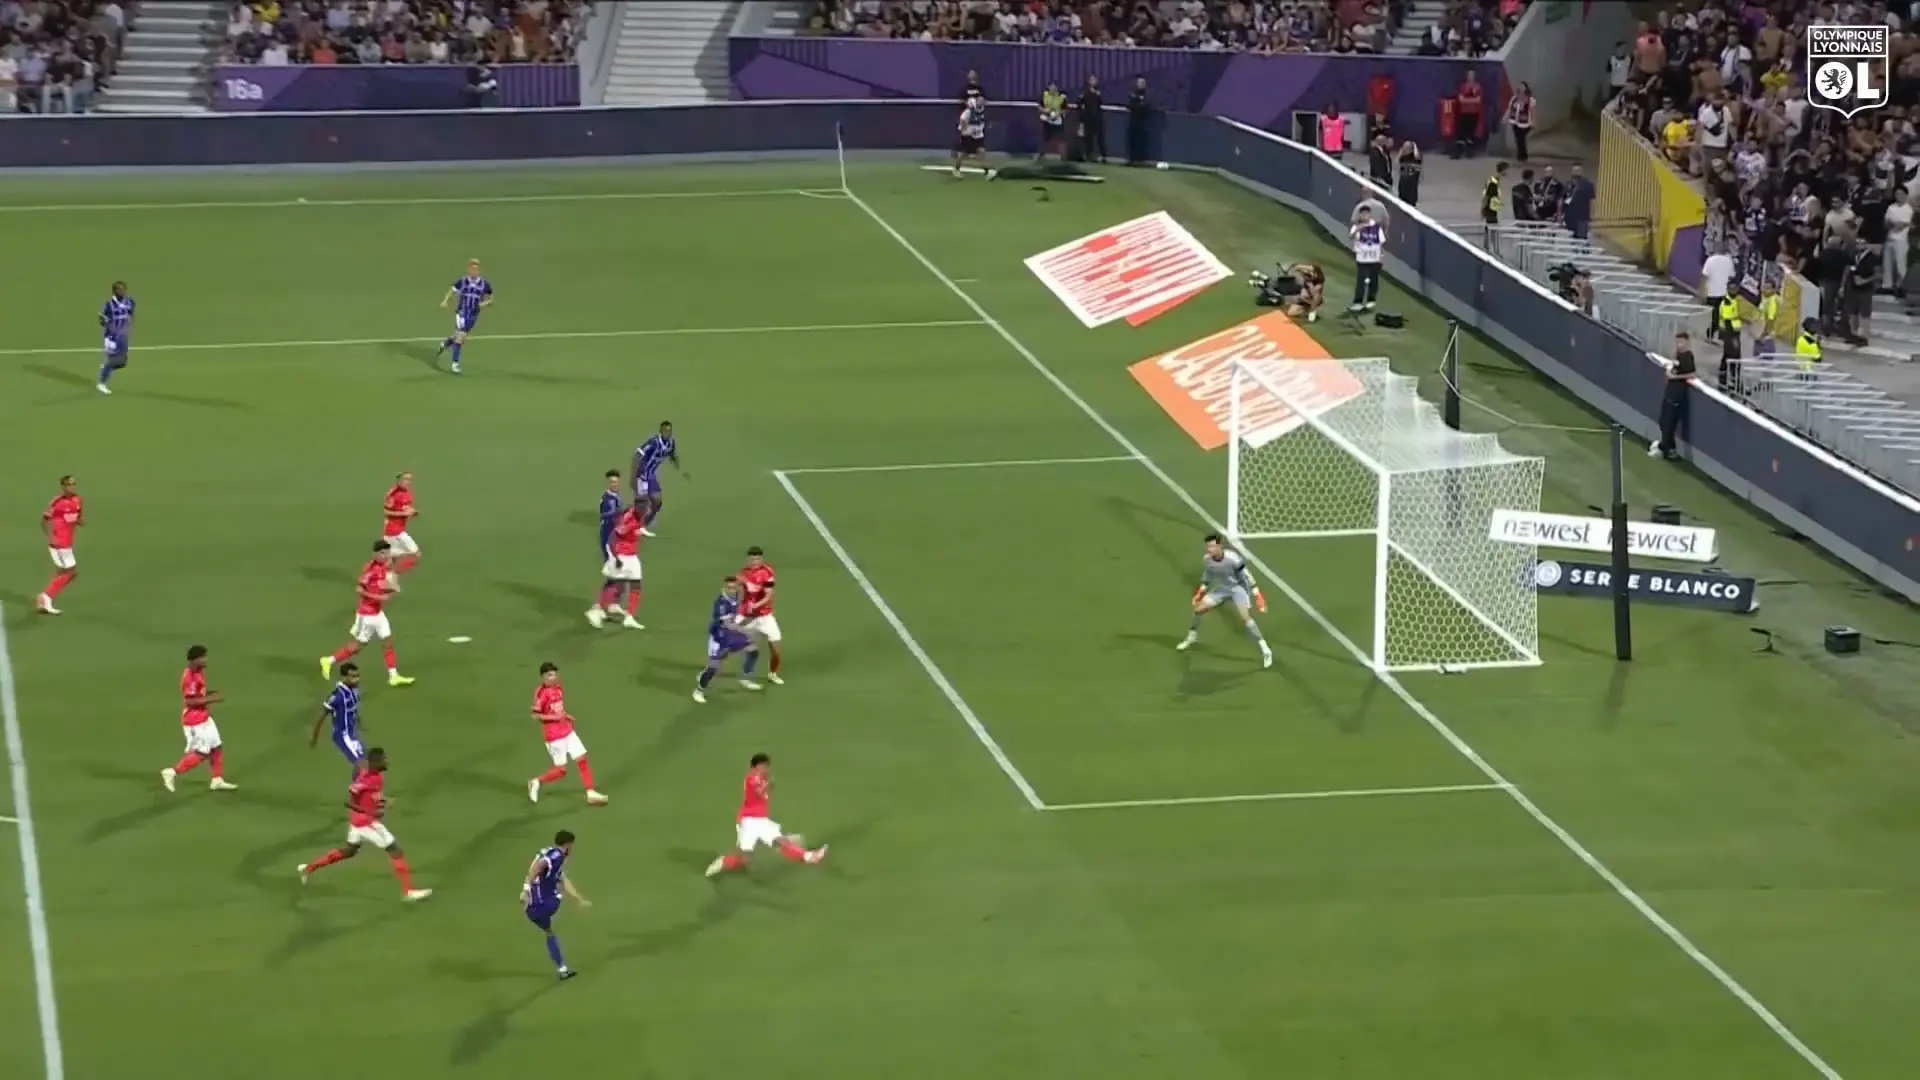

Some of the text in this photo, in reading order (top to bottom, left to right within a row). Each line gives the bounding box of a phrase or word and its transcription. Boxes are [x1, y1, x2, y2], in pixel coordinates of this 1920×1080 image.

[224, 78, 264, 99] 16a
[1503, 519, 1698, 553] newrest ewrest
[1569, 568, 1741, 599] SERE BLANCO
